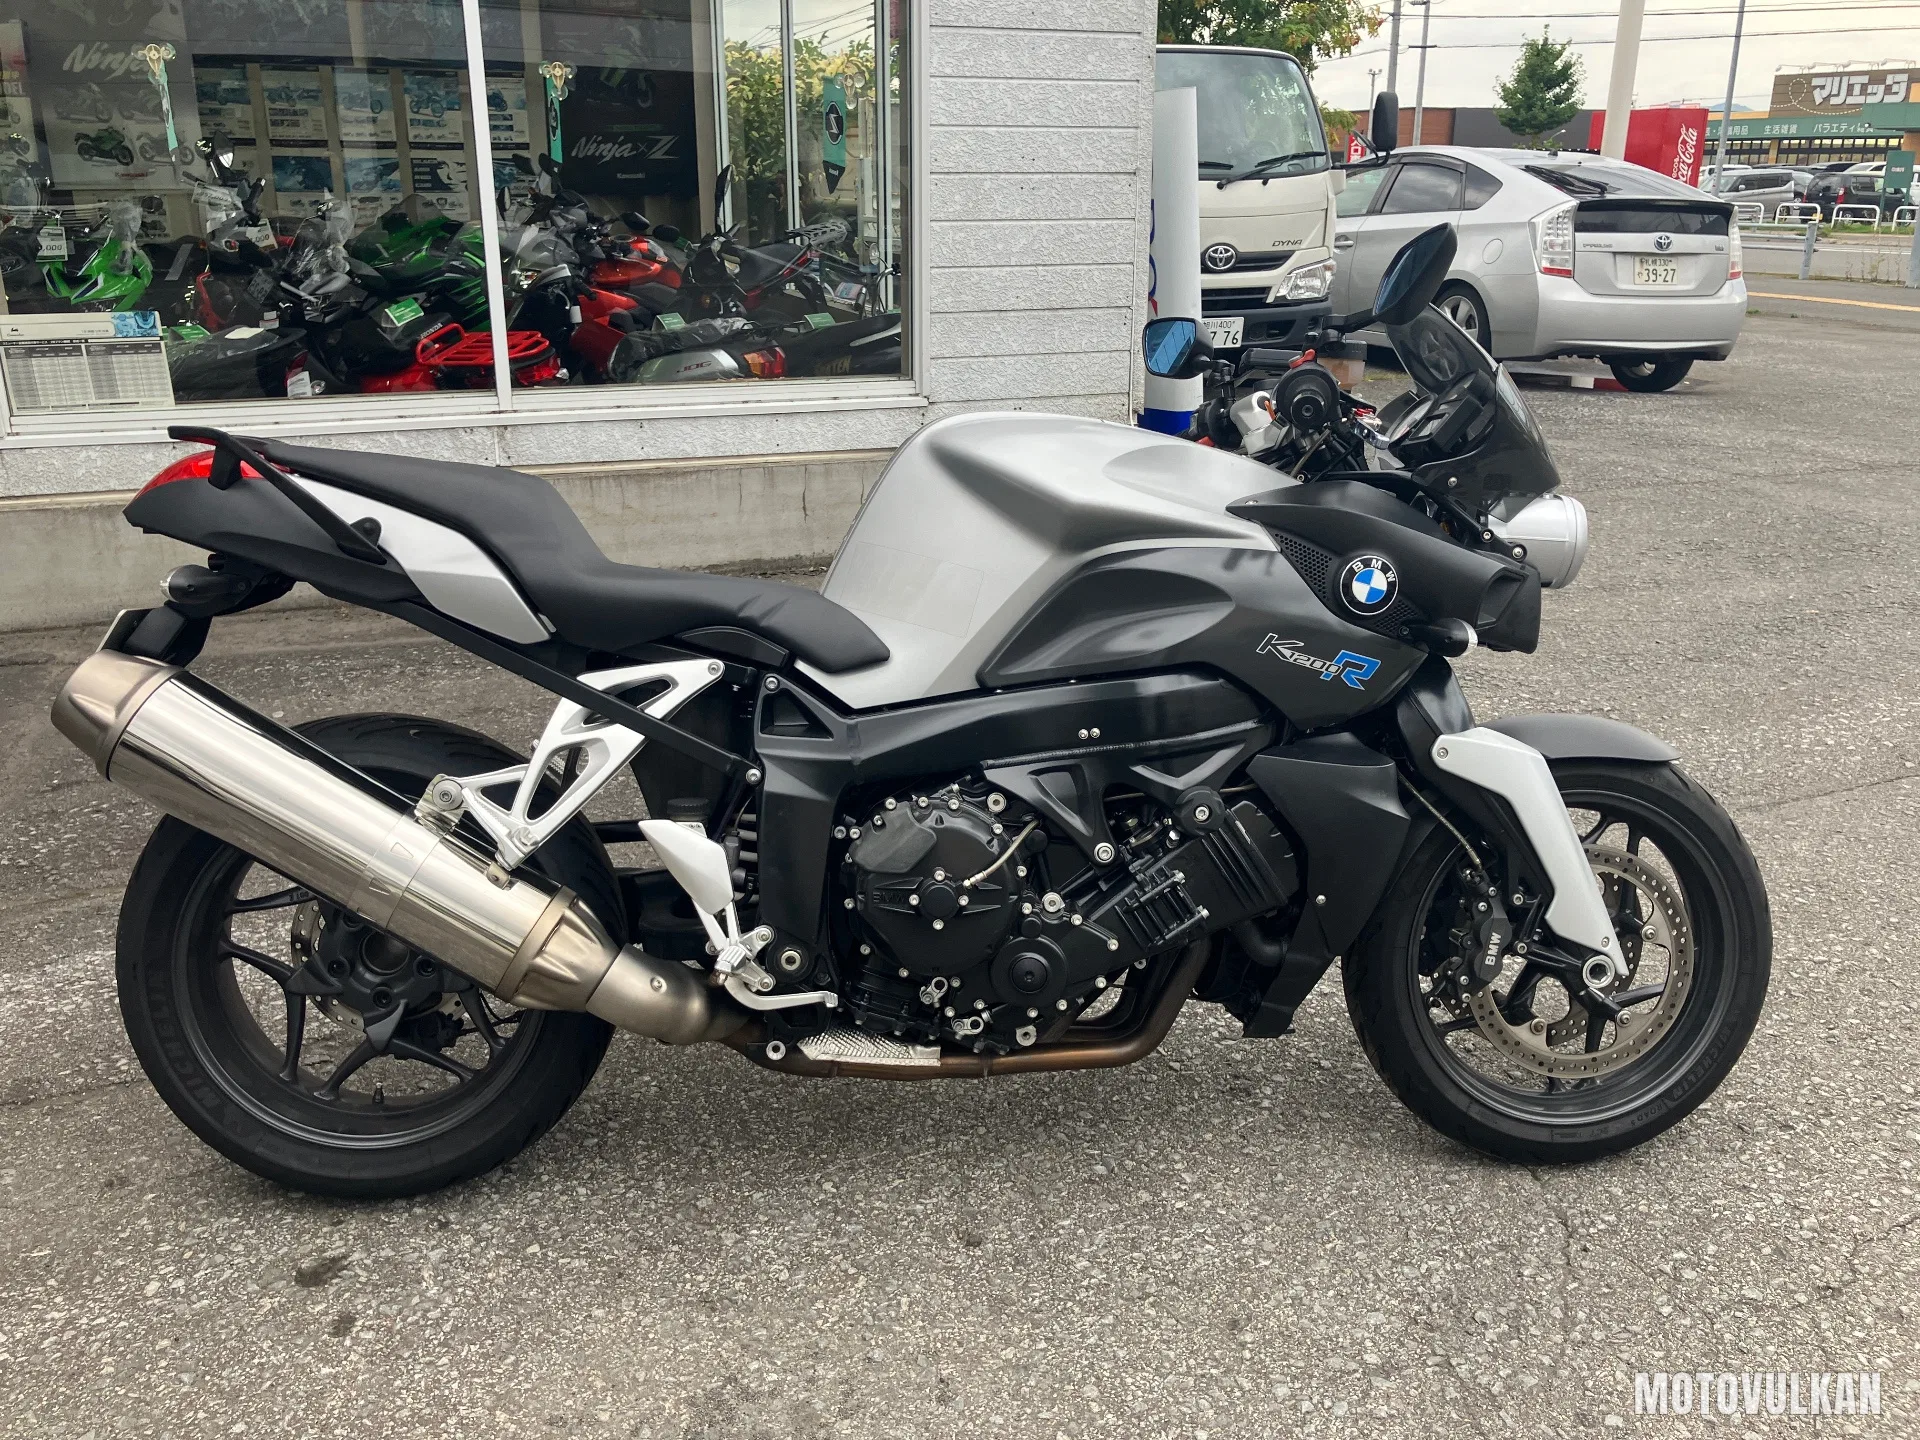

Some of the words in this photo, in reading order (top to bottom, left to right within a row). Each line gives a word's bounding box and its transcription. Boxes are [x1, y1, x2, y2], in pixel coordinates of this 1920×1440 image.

[63, 41, 151, 81] Ninja
[1811, 74, 1909, 106] マリエッタ
[1763, 124, 1798, 135] 生活雑貨
[571, 135, 637, 165] Ninja
[1272, 239, 1303, 247] DYNA
[1644, 268, 1677, 283] 39-27
[420, 322, 443, 339] HONDA
[1351, 558, 1396, 583] BMW
[1256, 632, 1382, 691] K1200R
[1484, 932, 1502, 966] BMW
